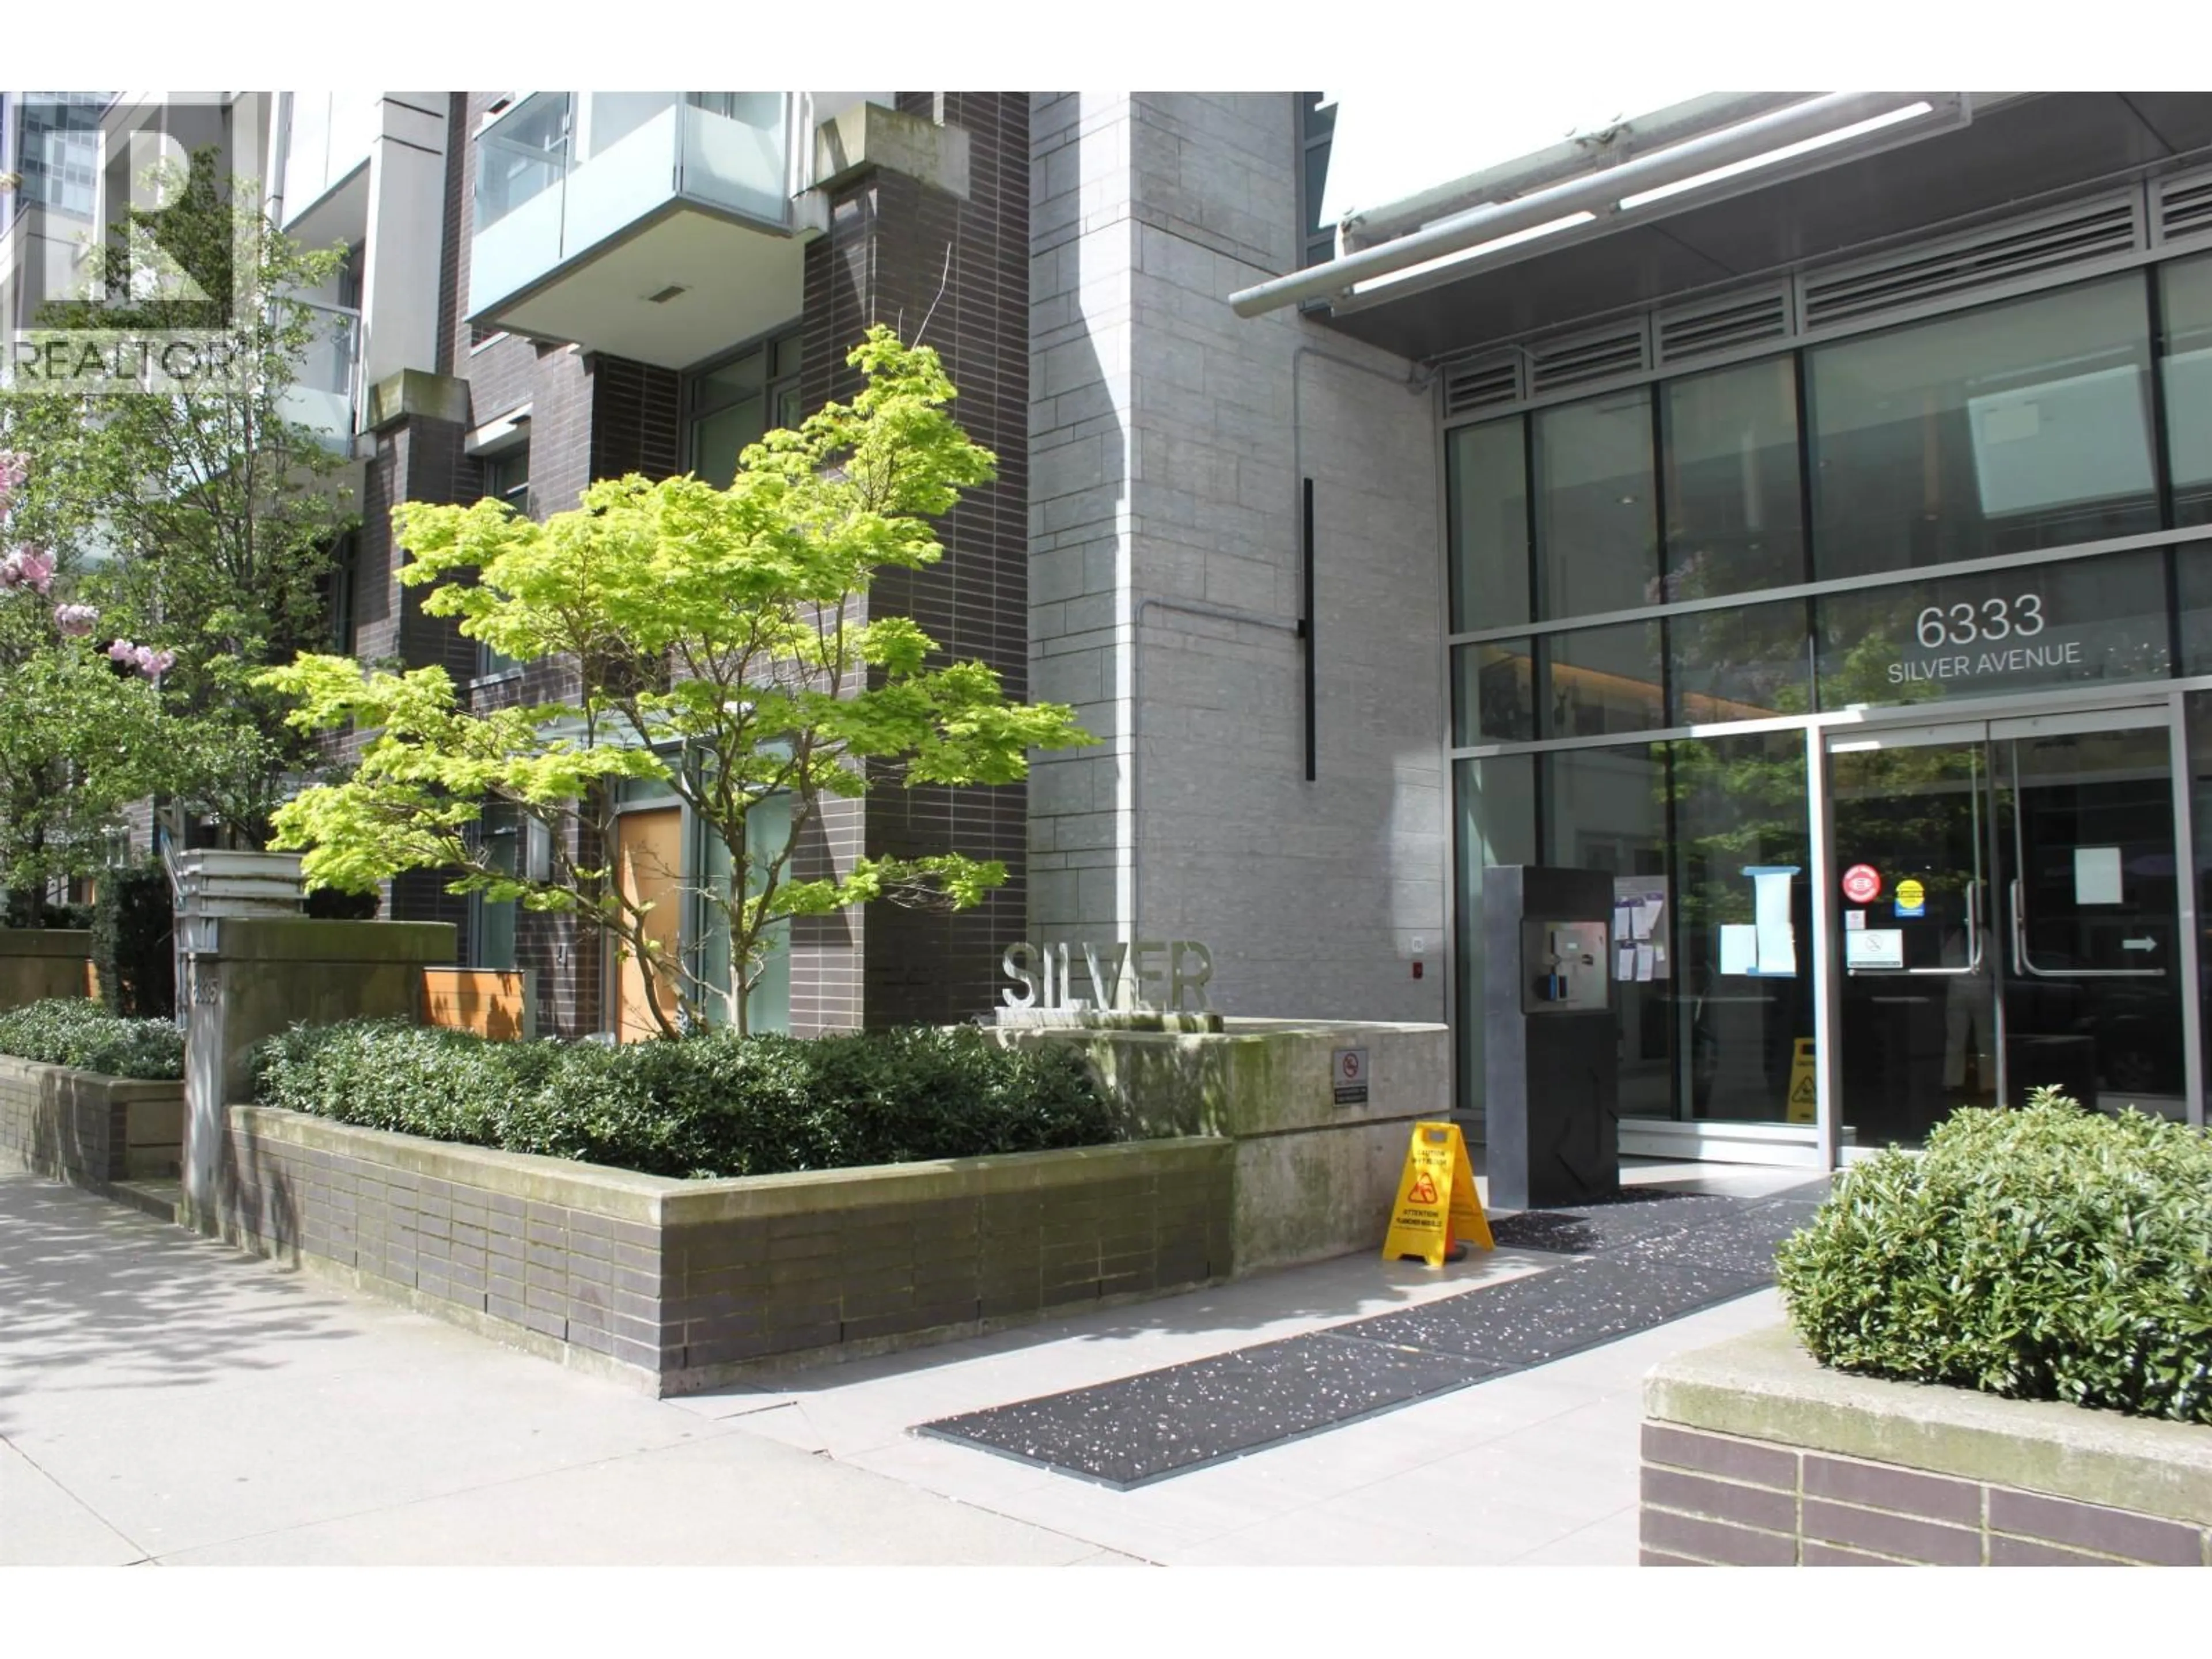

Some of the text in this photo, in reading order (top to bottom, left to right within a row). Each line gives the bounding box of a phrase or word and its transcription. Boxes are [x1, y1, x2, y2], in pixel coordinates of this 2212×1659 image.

[1916, 594, 2044, 648] 6333
[1888, 642, 2081, 683] SILVER AVENUE
[1002, 941, 1214, 1012] SILVER
